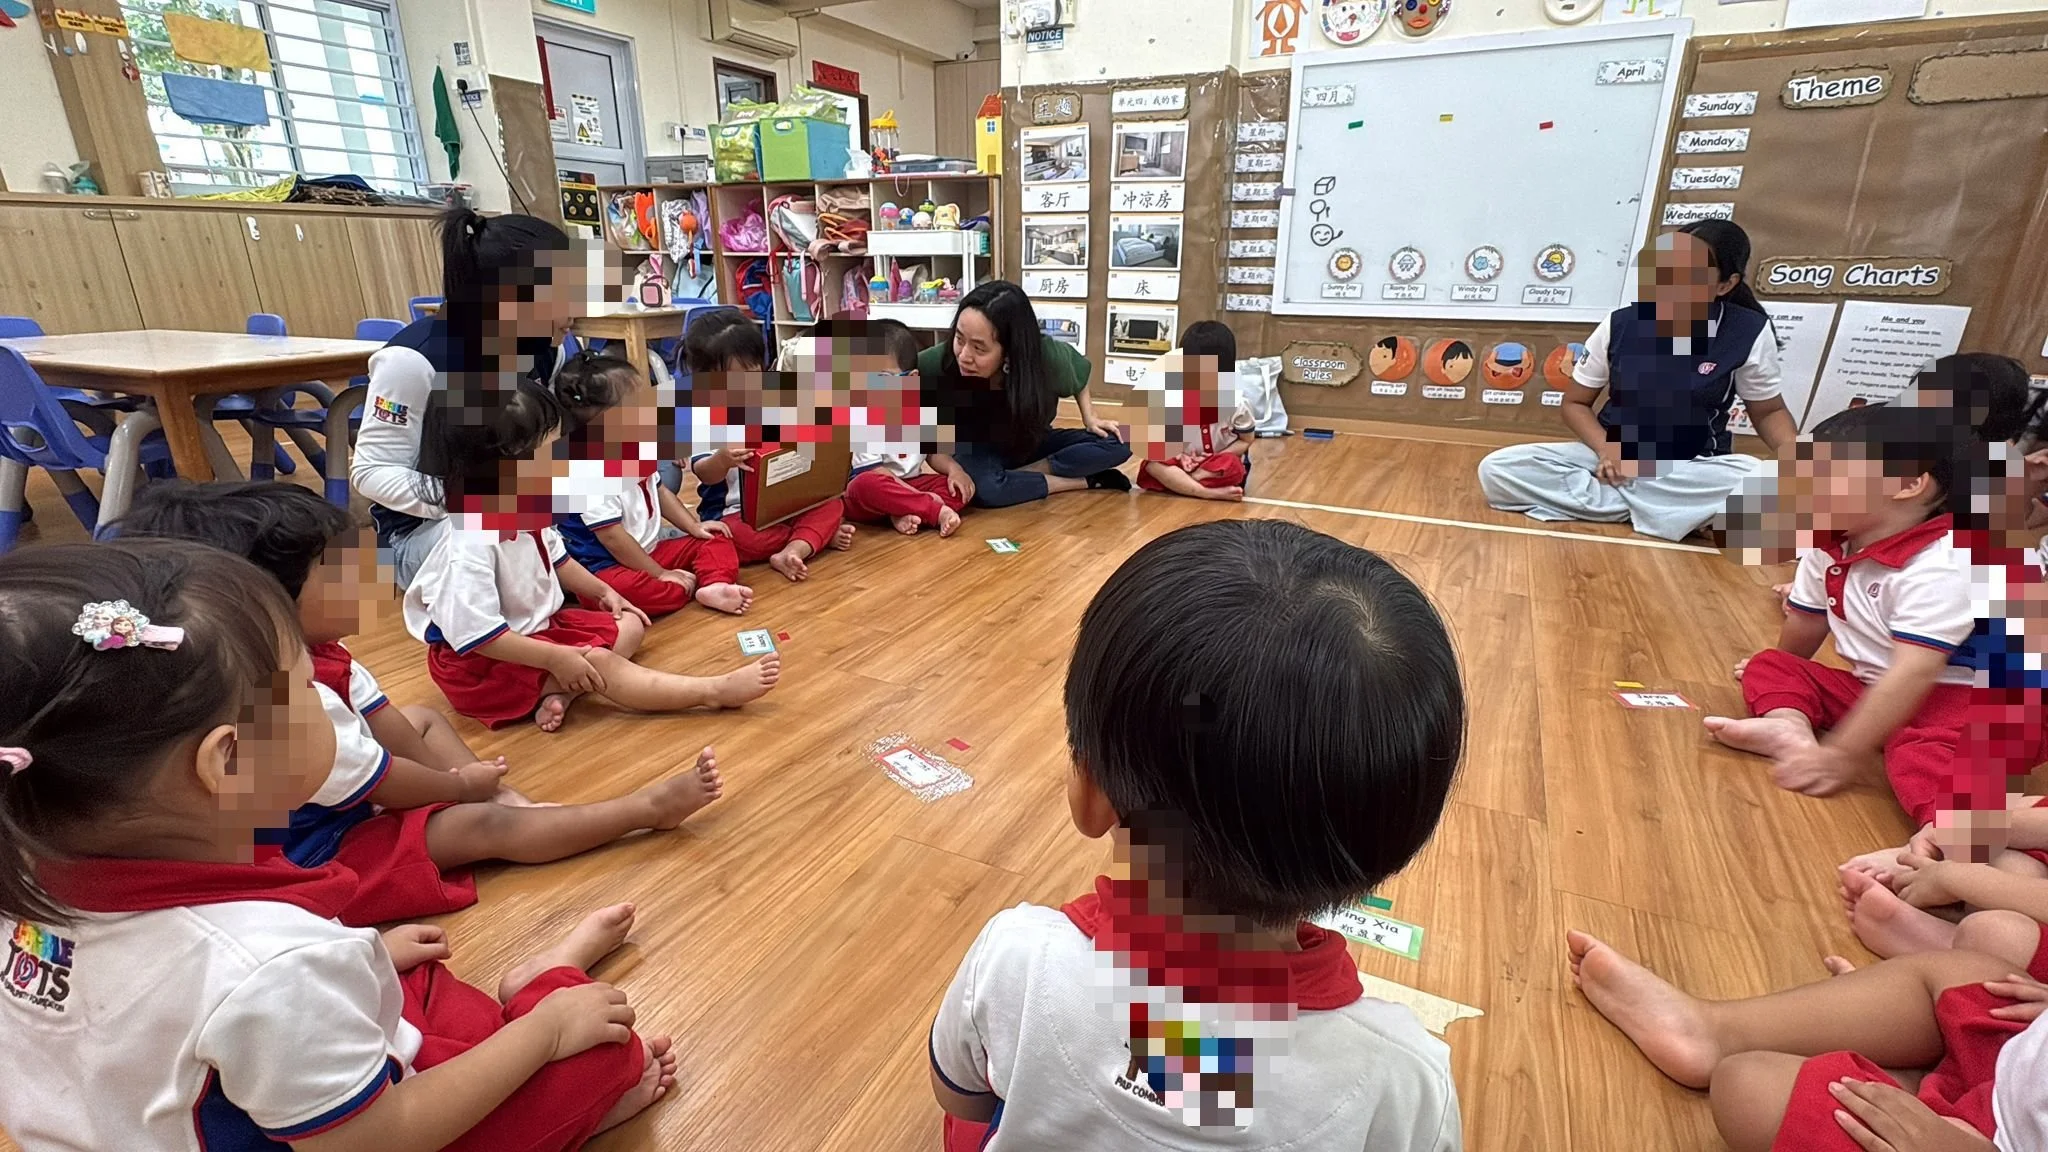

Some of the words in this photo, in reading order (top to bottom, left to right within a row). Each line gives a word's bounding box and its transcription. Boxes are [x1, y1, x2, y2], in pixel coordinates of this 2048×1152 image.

[1027, 29, 1062, 41] NOTICE
[1617, 65, 1646, 79] April
[1790, 77, 1881, 101] Theme
[1316, 90, 1338, 103] 四月
[1036, 97, 1073, 119] 主题
[1698, 100, 1743, 112] Sunday
[1249, 127, 1275, 137] 星期一
[1689, 136, 1736, 147] Monday
[1247, 159, 1272, 168] 星期二
[1682, 173, 1731, 185] Tuesday
[1244, 188, 1270, 197] 星期三
[1040, 191, 1071, 209] 客厅
[1122, 189, 1173, 210] 冲凉房
[1243, 214, 1268, 224] 星期四
[1665, 209, 1731, 220] Wednesday
[1770, 264, 1833, 287] Song
[1845, 264, 1939, 285] Charts
[1038, 277, 1070, 295] 厨房
[1134, 279, 1152, 297] 床
[1528, 288, 1551, 297] Cloudy
[1552, 288, 1566, 296] Day
[1292, 356, 1346, 370] Classroom
[1303, 368, 1332, 380] Rules
[1373, 918, 1400, 934] Xia
[1115, 1075, 1132, 1091] PAP
